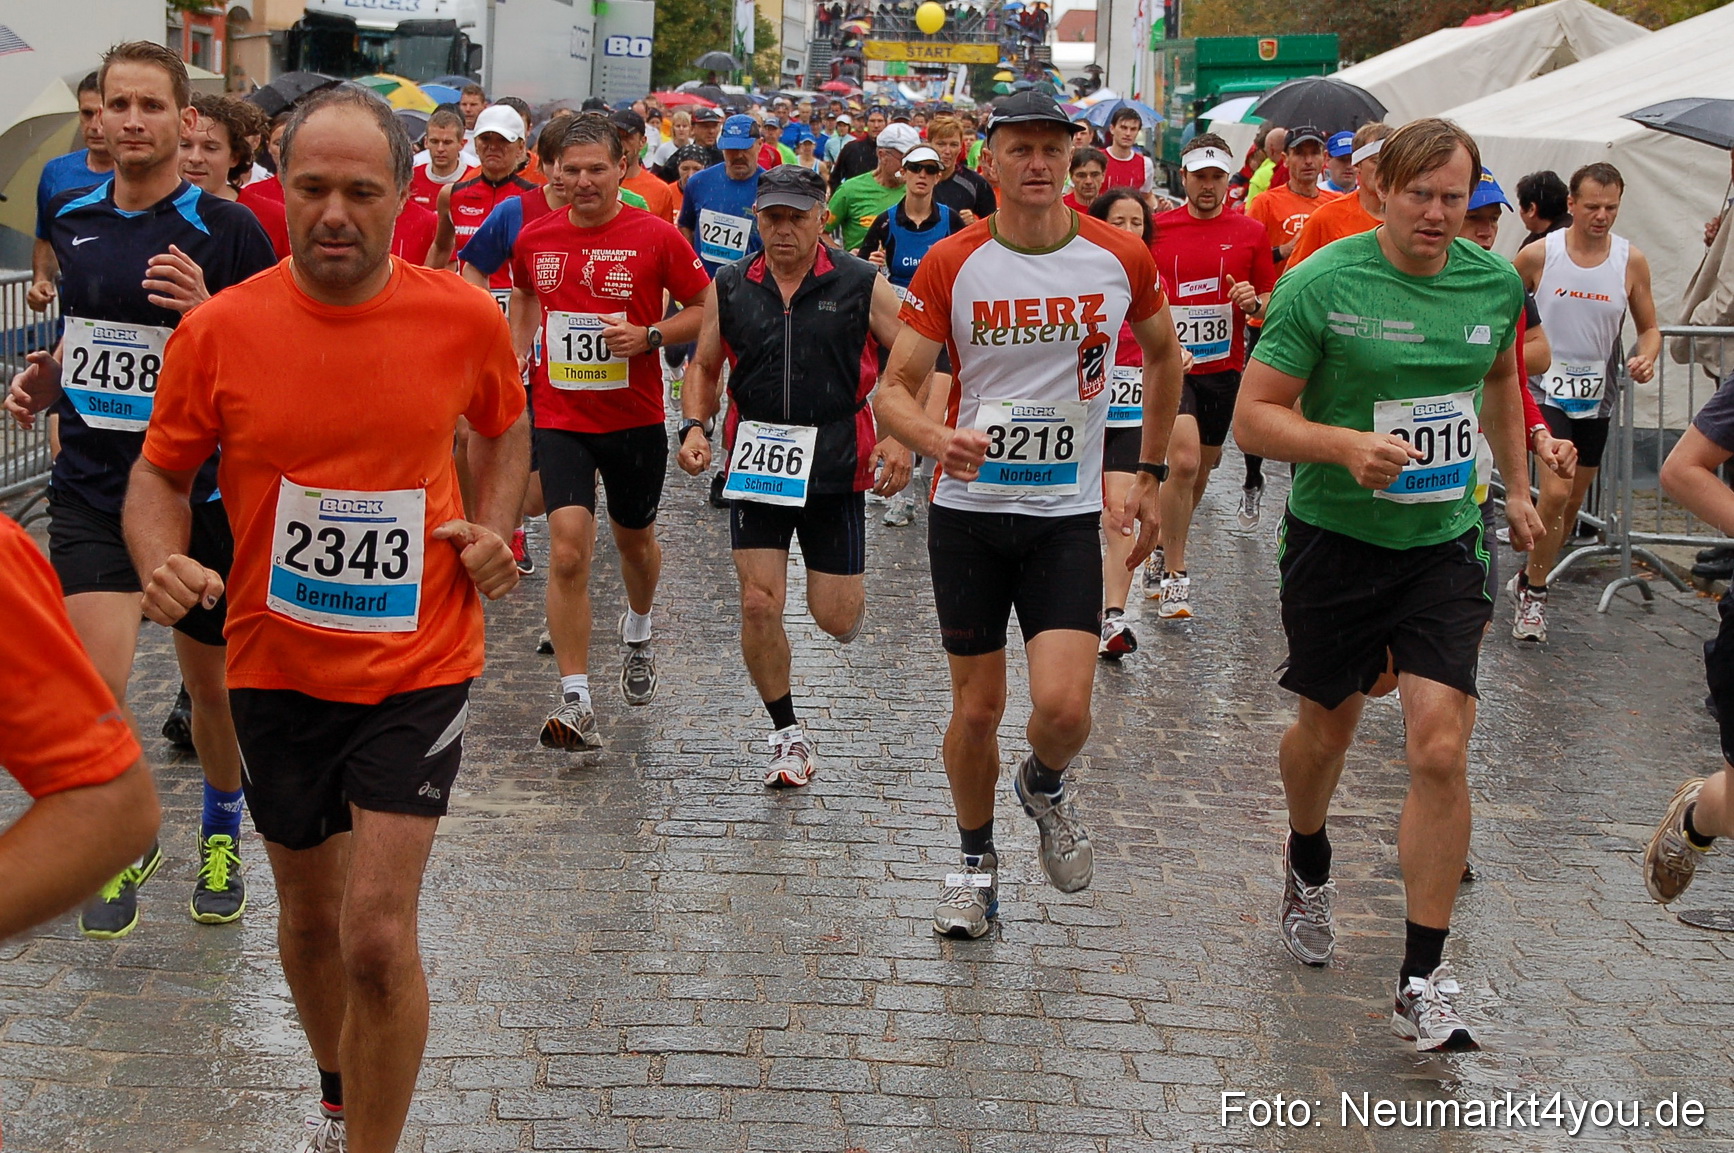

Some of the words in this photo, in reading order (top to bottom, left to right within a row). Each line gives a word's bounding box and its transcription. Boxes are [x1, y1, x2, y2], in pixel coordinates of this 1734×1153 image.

[906, 46, 952, 58] START
[703, 223, 743, 249] 2214
[537, 270, 558, 280] NEU
[1569, 290, 1612, 302] KLEBL
[569, 317, 601, 326] BOCK
[972, 293, 1107, 331] MERZ
[93, 327, 137, 341] BOCK
[970, 319, 1080, 345] Reisen
[1176, 319, 1228, 343] 2138
[562, 333, 611, 362] 130
[72, 346, 161, 393] 2438
[564, 367, 607, 380] Thomas
[1552, 376, 1603, 399] 2187
[88, 396, 132, 416] Stefan
[1011, 406, 1056, 417] BOCK
[1412, 401, 1454, 416] BOCK
[985, 425, 1074, 461] 3218
[737, 441, 804, 476] 2466
[744, 477, 783, 493] Schmid
[1000, 468, 1052, 482] Norbert
[1405, 468, 1460, 490] Gerhard
[319, 498, 384, 515] BOCK
[284, 520, 410, 580] 2343
[296, 582, 388, 612] Bernhard
